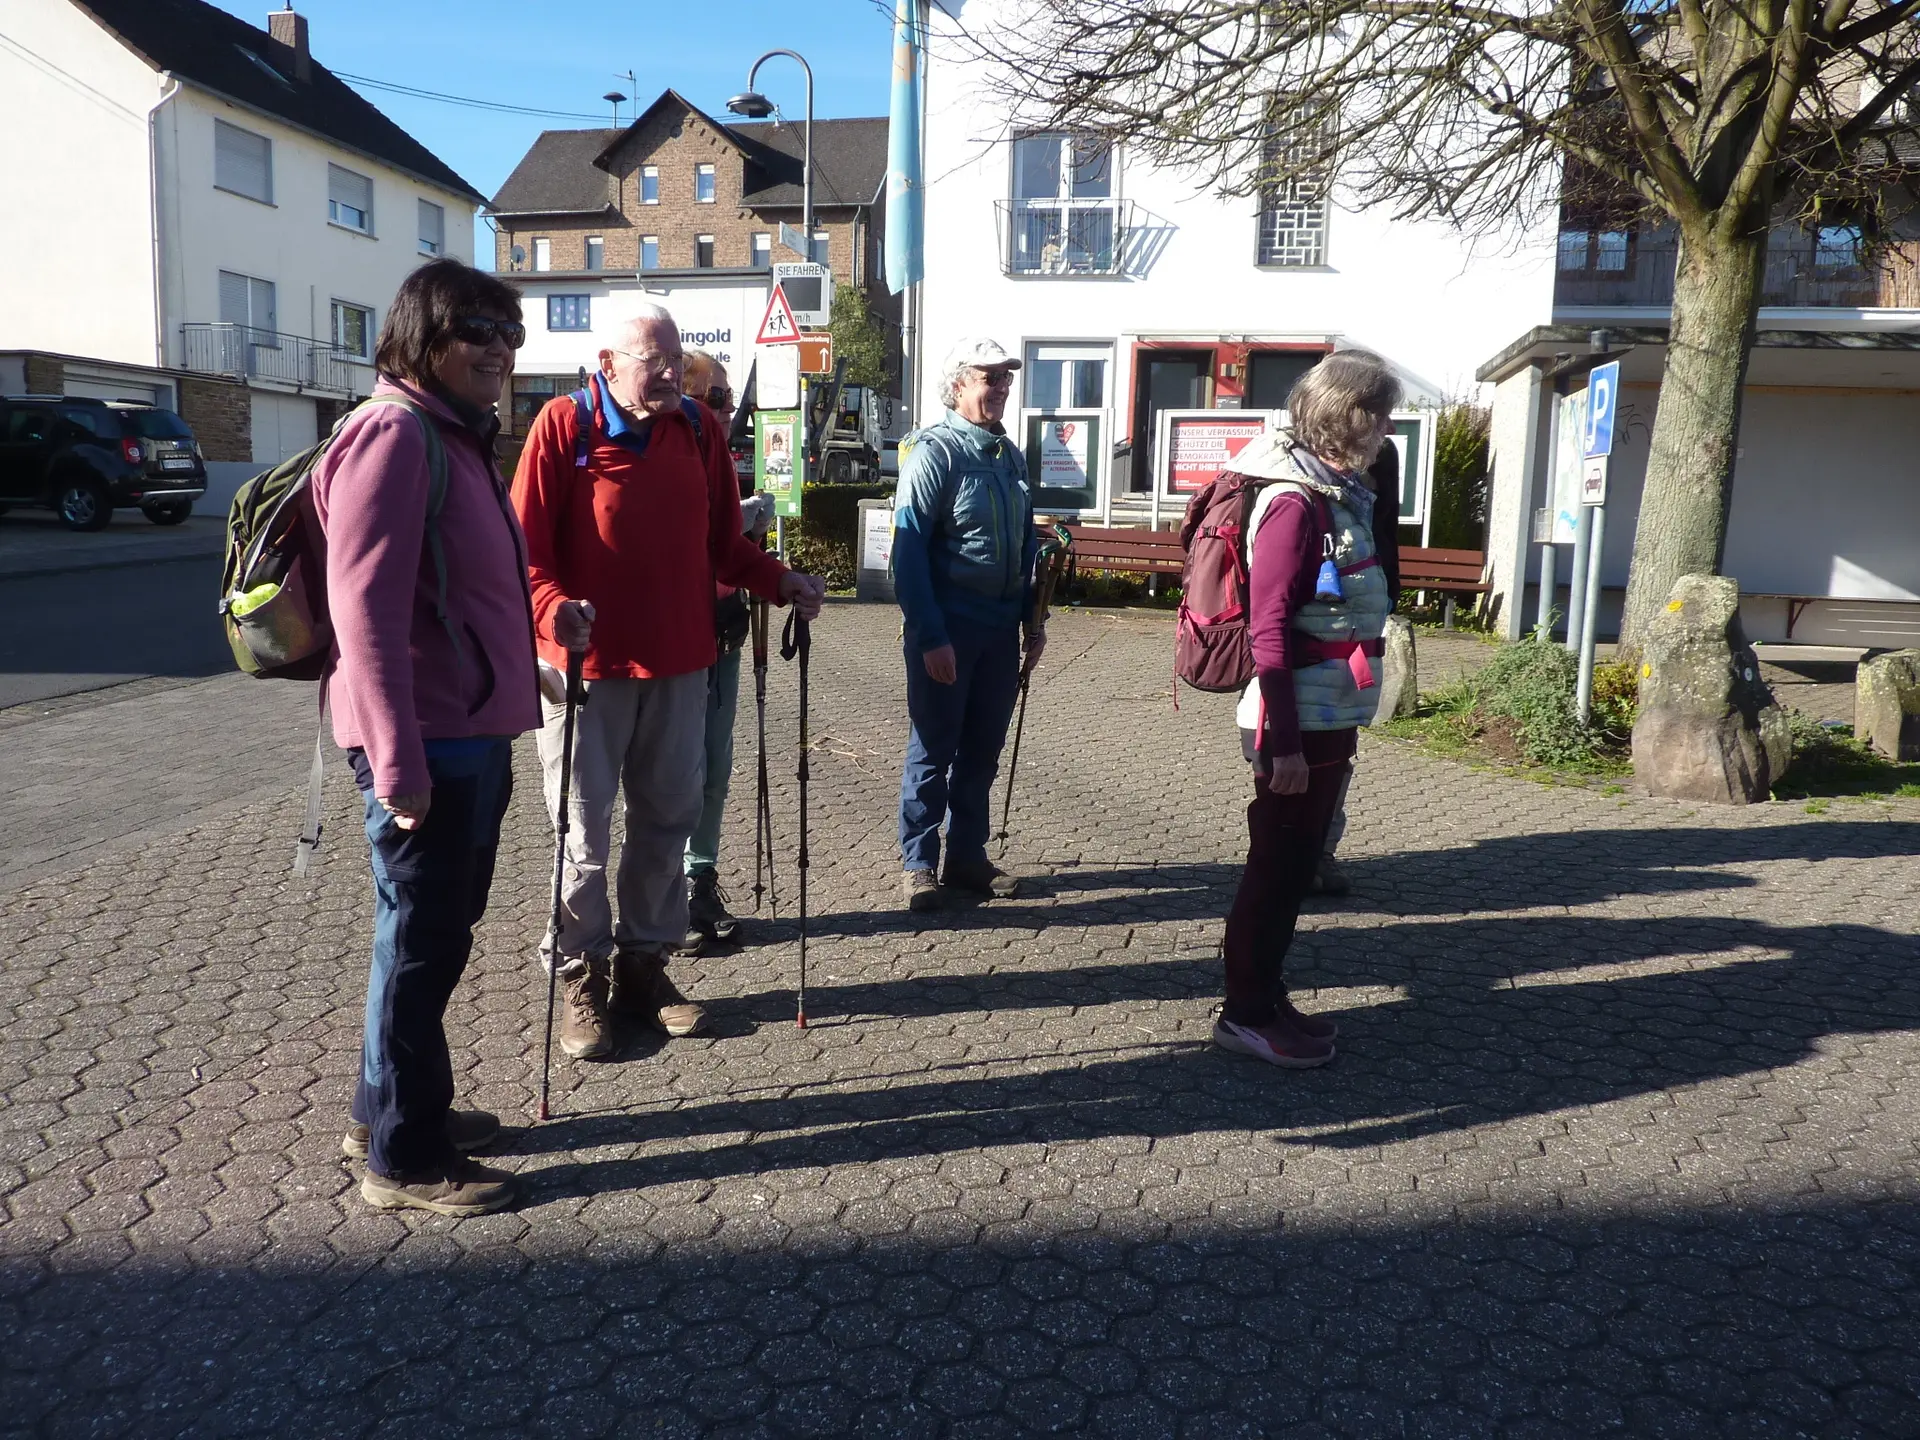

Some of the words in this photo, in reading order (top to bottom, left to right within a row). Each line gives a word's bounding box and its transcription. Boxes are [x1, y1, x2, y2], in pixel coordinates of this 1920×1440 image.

[777, 265, 791, 276] SIE
[792, 265, 826, 276] FAHREN
[793, 312, 811, 323] m/h
[680, 328, 732, 346] ingold
[1591, 378, 1610, 446] P
[1175, 428, 1205, 436] UNSERE
[1207, 428, 1260, 436] VERFASSUNG
[1174, 439, 1209, 448] SCHÜTZT
[1210, 440, 1224, 448] DIE
[1173, 452, 1225, 460] DEMOKRATIE
[1173, 463, 1198, 471] NICHT
